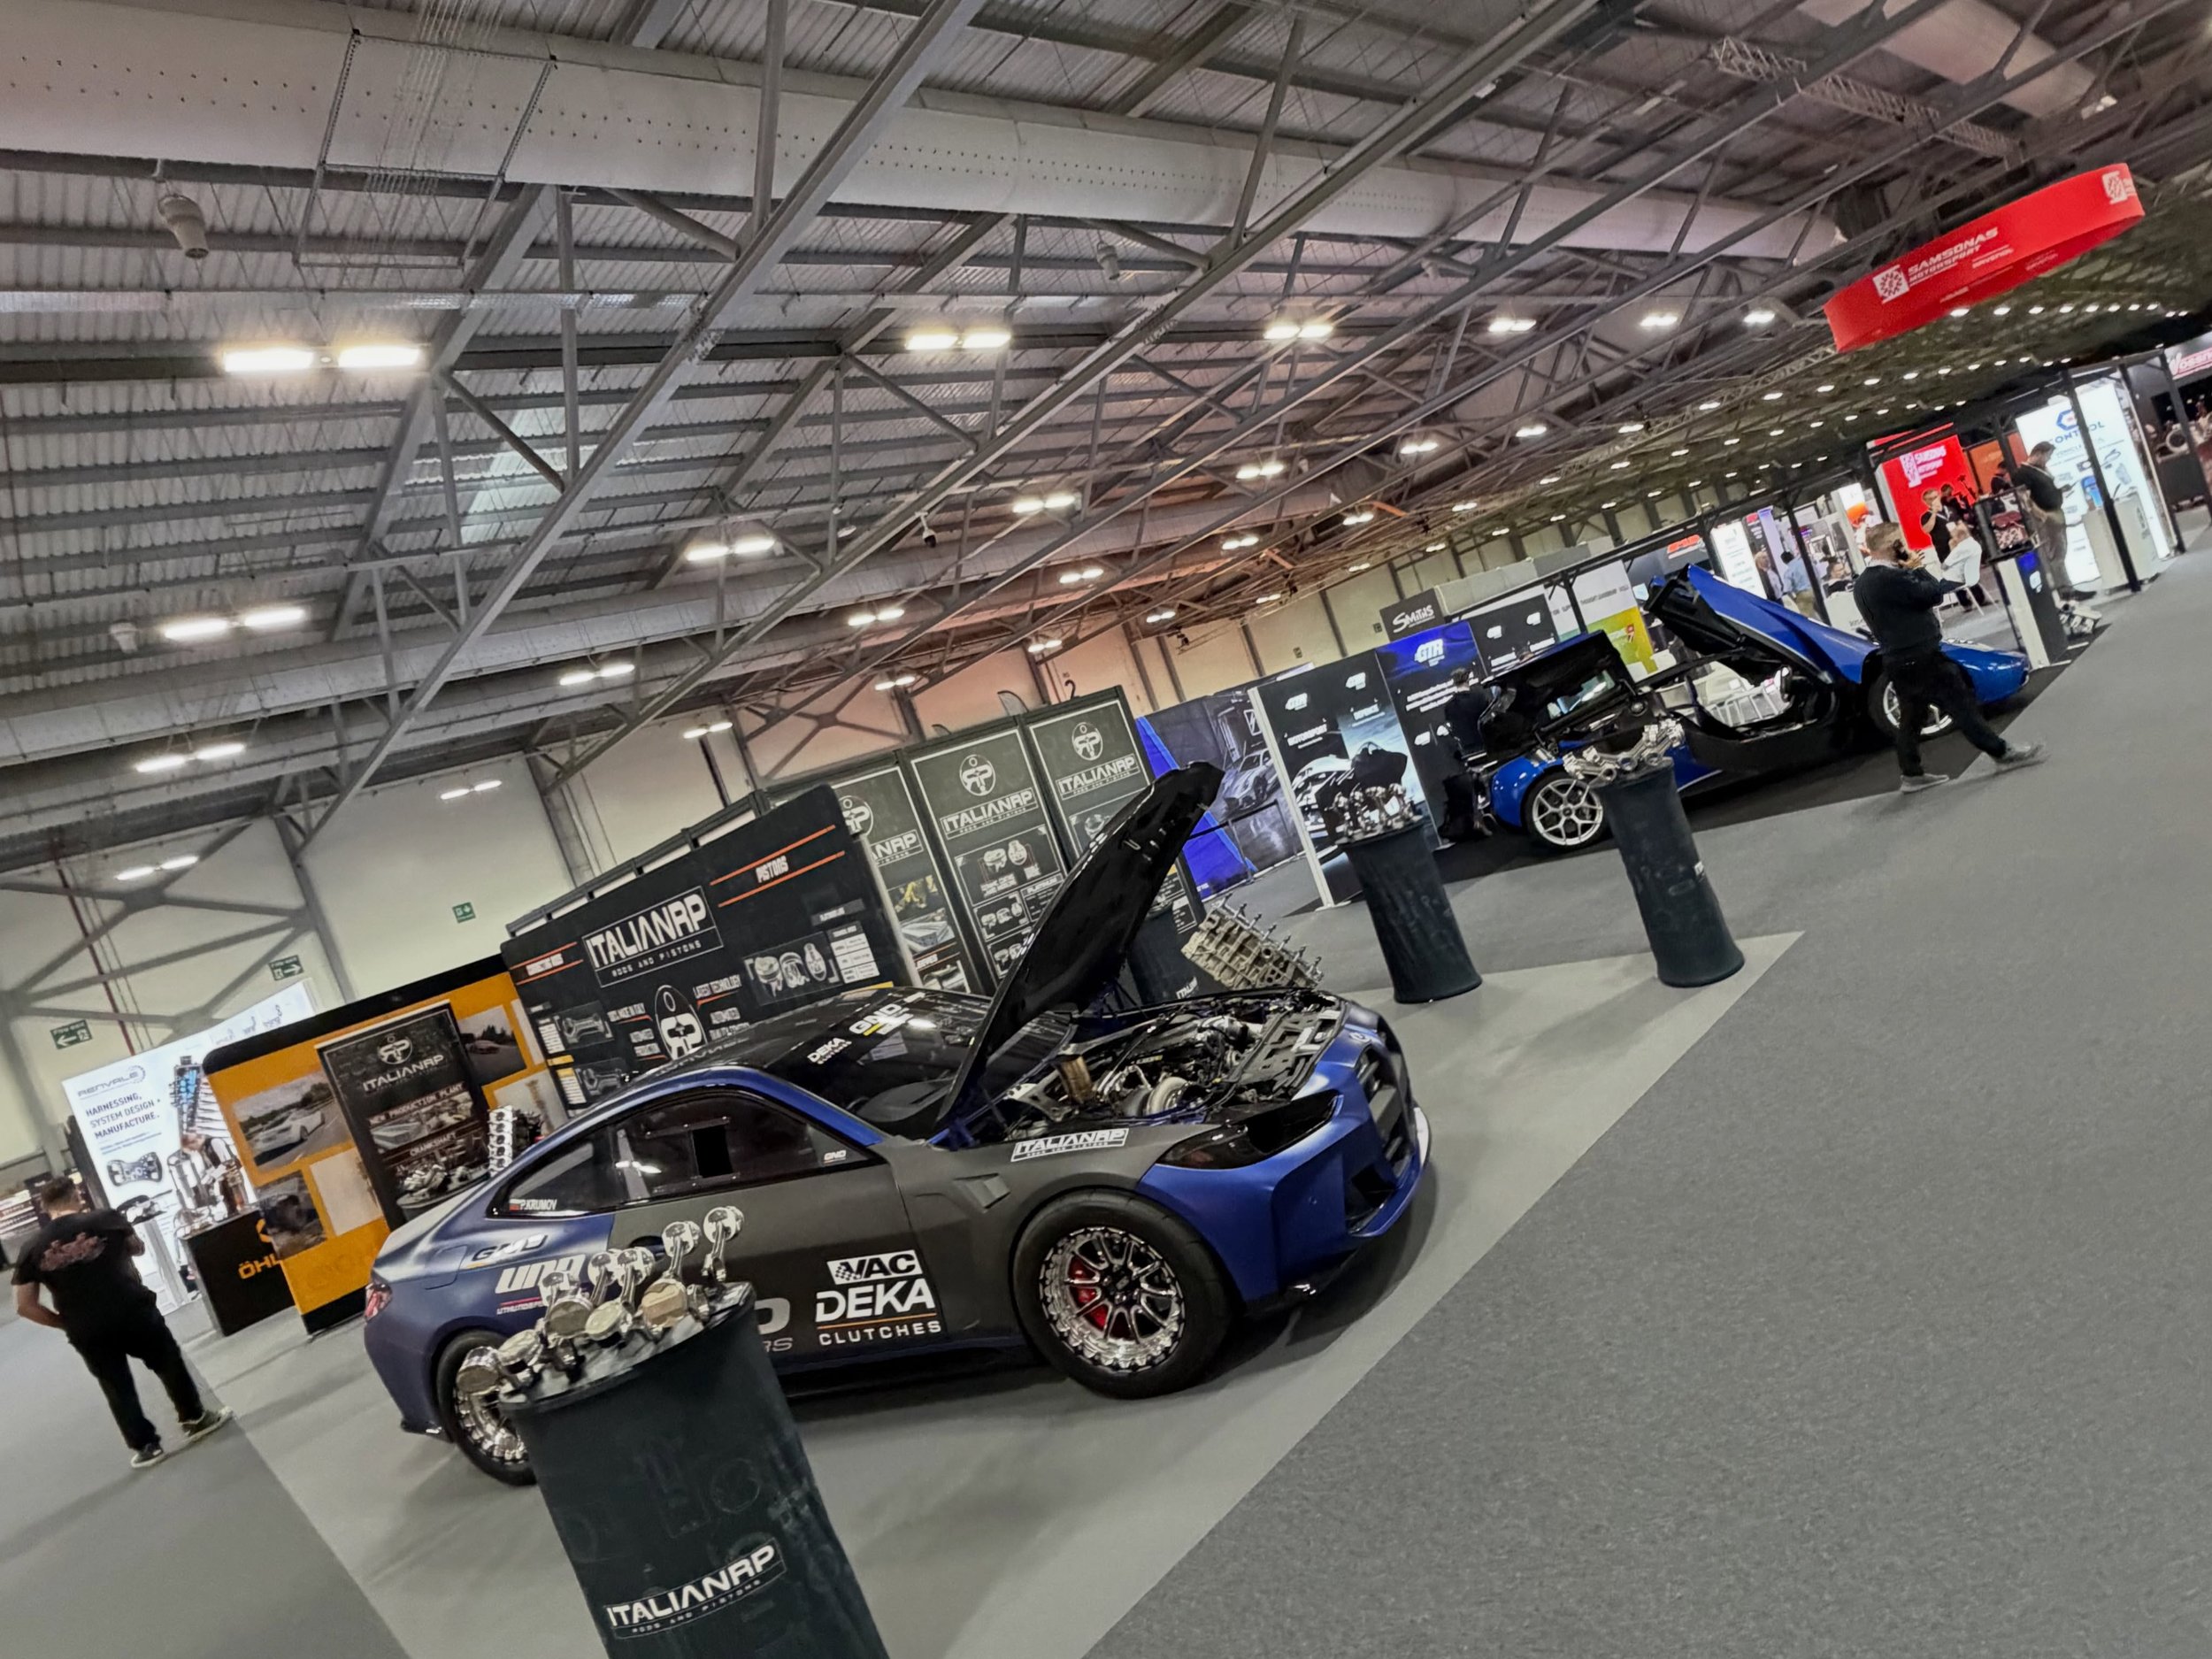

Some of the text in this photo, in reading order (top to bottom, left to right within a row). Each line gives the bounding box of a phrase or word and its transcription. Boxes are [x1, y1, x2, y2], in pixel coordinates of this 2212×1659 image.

[1909, 227, 1998, 275] SAMSONAS
[1909, 245, 1981, 282] MOTORSPORT
[2048, 421, 2105, 444] ONTOL
[1058, 757, 1135, 793] ITALIANRP
[943, 790, 1033, 832] ITALIANRP
[756, 855, 789, 883] PISTONS
[586, 894, 707, 968] ITALIANRP
[638, 956, 655, 968] AND
[659, 940, 702, 961] PISTONS
[807, 1037, 845, 1063] DEKA
[78, 1071, 139, 1097] RENVALE
[363, 1055, 444, 1091] ITALIANRP
[86, 1093, 142, 1117] HARNESSING,
[90, 1110, 122, 1128] SYSTEM
[125, 1100, 154, 1116] DESIGN
[388, 1094, 437, 1118] PRODUCTION
[441, 1083, 464, 1099] PLANT
[95, 1112, 160, 1139] MANUFACTURE.
[410, 1132, 457, 1156] CRANKSHAFT
[1018, 1128, 1125, 1154] ITALIANRP
[238, 1252, 280, 1279] ÖHL
[835, 1254, 916, 1280] VAC
[815, 1278, 936, 1323] DEKA
[818, 1320, 941, 1346] CLUTCHES
[607, 1545, 775, 1626] ITALIANRP
